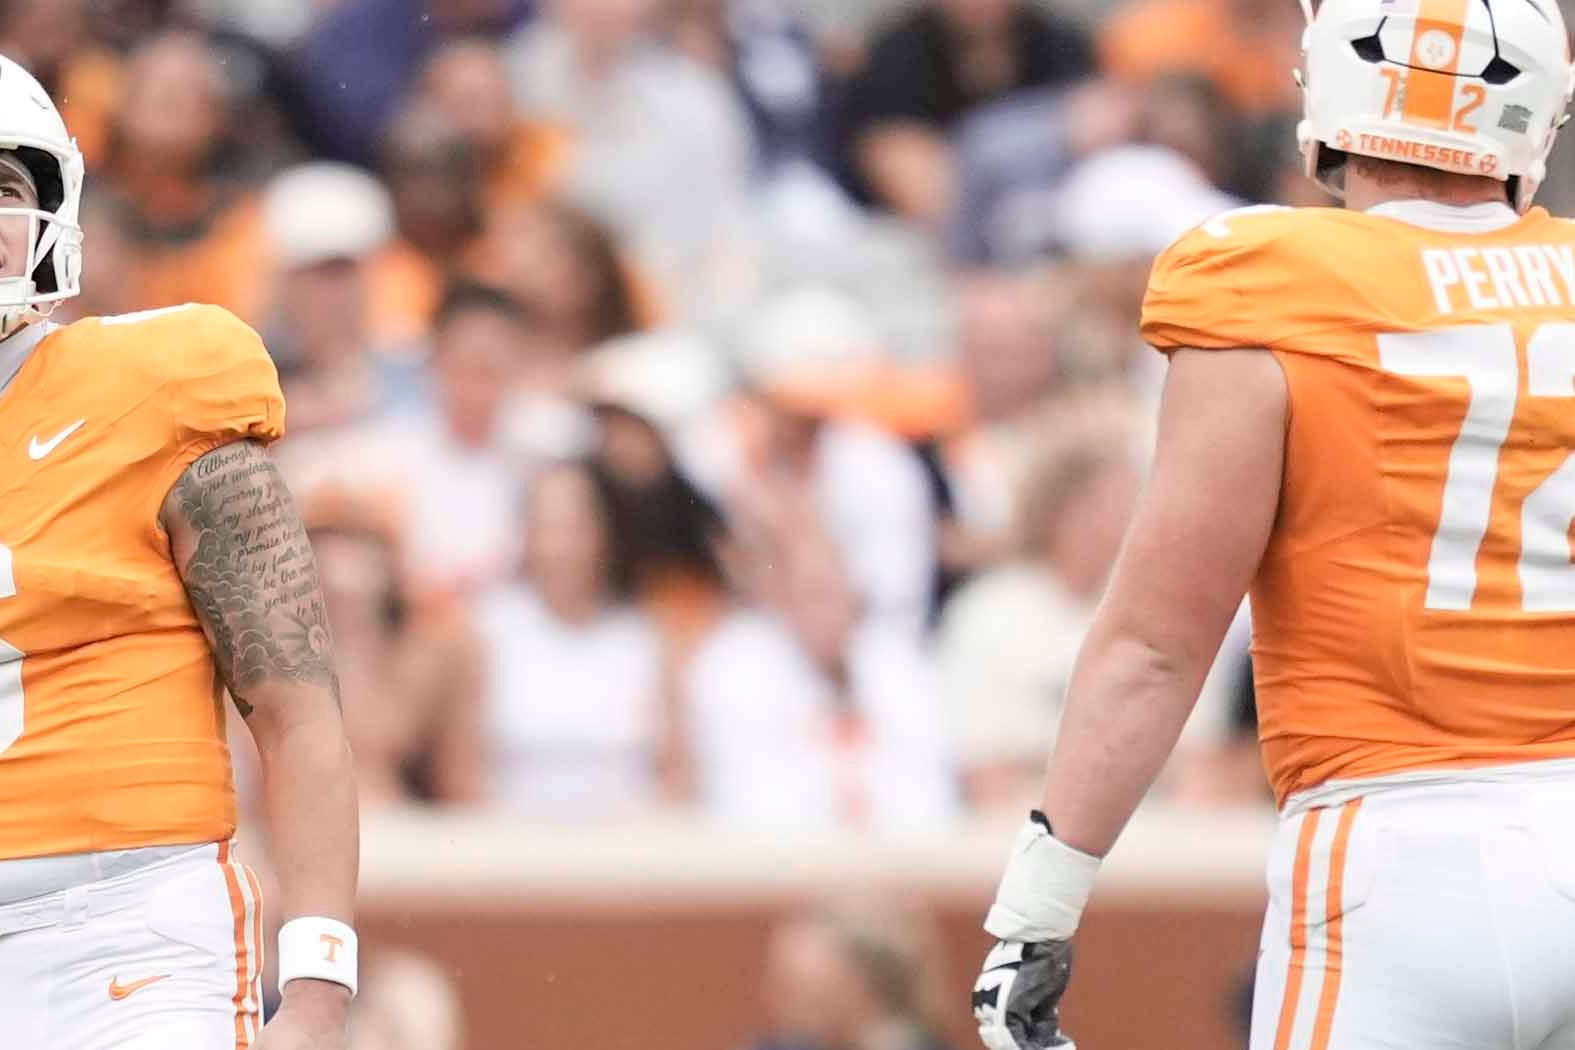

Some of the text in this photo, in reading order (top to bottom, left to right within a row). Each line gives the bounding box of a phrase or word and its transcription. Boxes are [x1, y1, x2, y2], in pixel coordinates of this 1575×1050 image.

[1379, 67, 1487, 134] 7 2
[1358, 133, 1475, 169] TENNESSEE
[1421, 244, 1575, 315] PERRY
[319, 932, 345, 964] T
